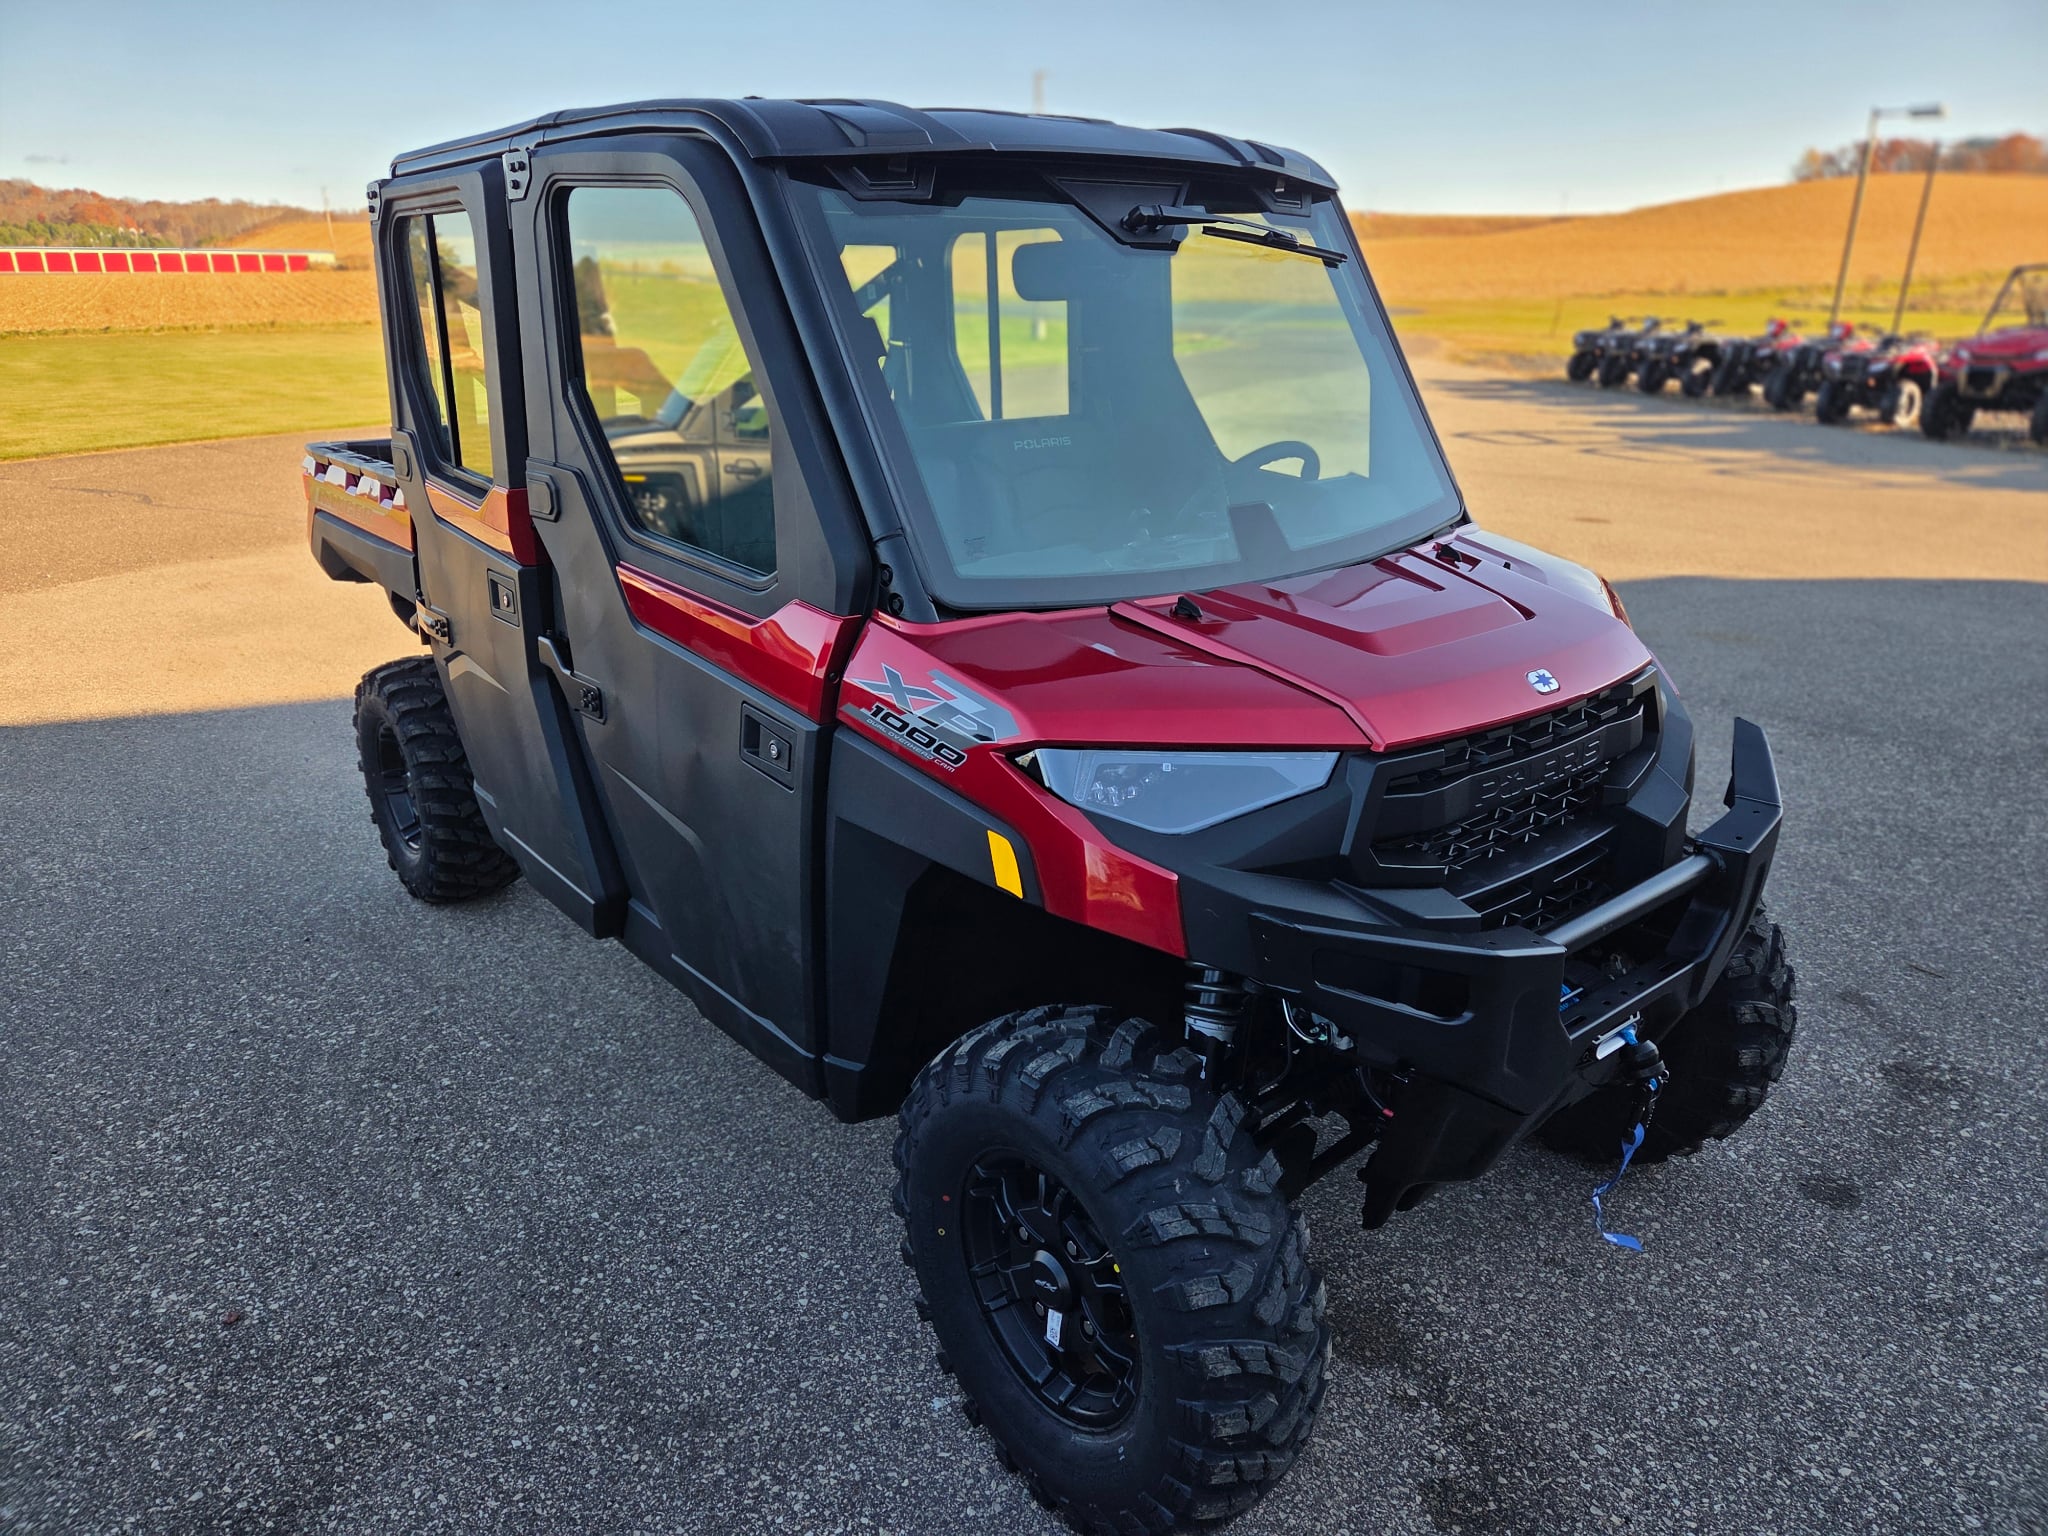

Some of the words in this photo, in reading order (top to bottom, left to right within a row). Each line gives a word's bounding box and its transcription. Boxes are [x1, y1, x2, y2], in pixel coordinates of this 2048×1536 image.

[1014, 436, 1072, 451] POLARIS
[851, 663, 999, 744] XP
[861, 701, 968, 767] 1000
[866, 718, 887, 734] DUAL
[934, 758, 956, 773] CAM
[1472, 738, 1602, 808] POLARIS
